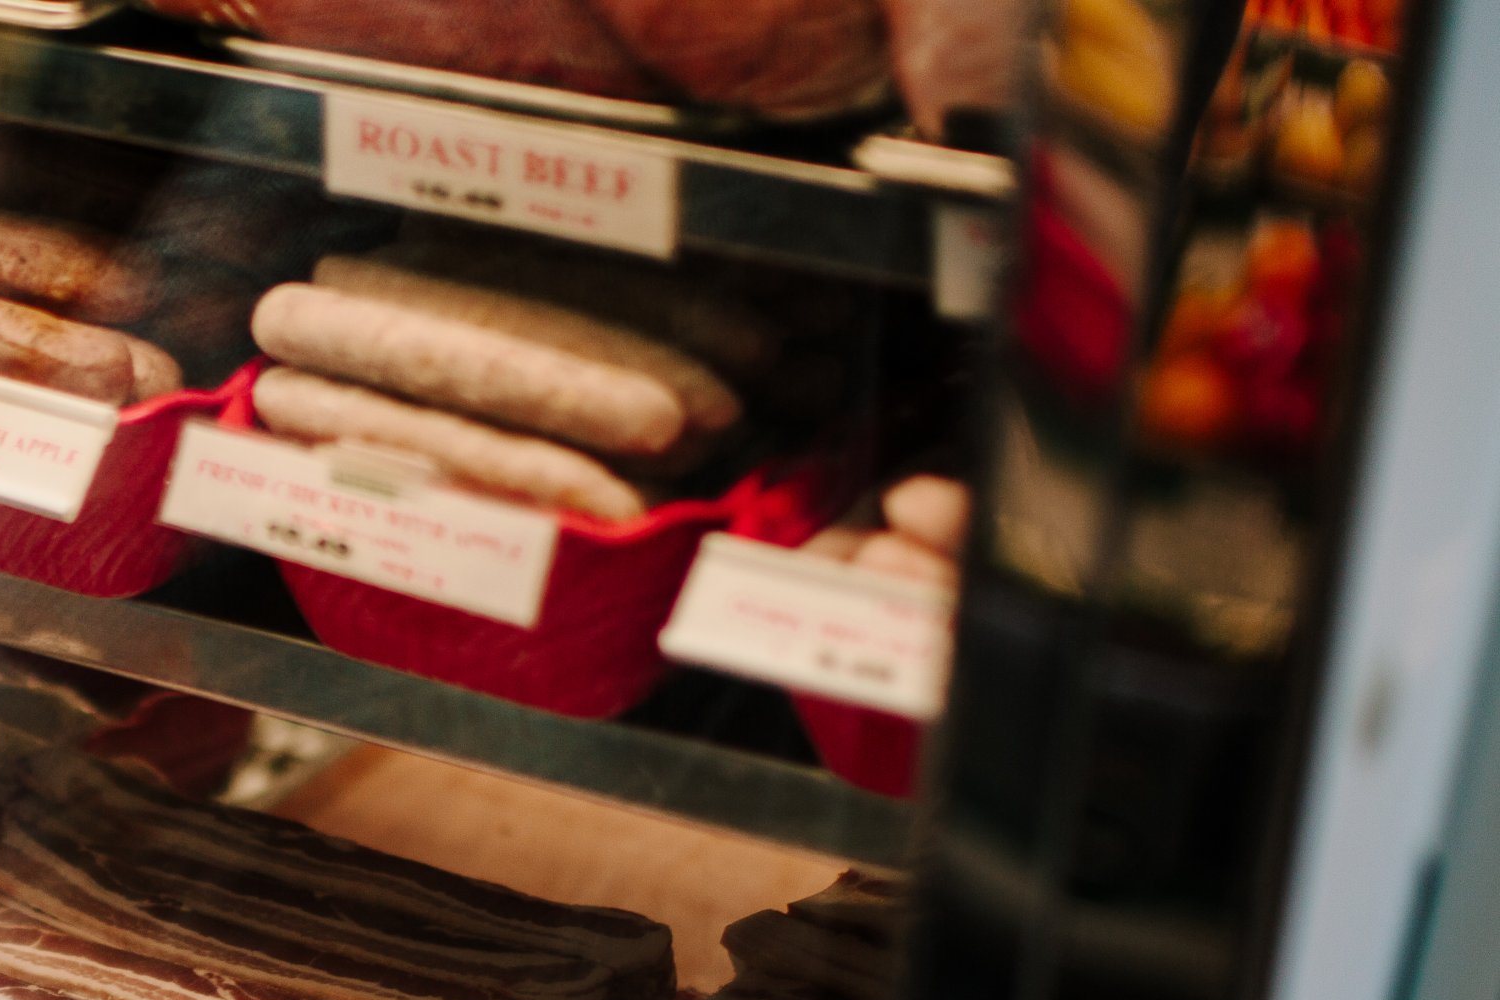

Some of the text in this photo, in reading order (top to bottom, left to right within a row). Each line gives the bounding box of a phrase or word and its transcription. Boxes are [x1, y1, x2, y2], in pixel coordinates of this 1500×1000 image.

[357, 118, 641, 203] ROAST BEEF
[13, 435, 81, 467] APPLE
